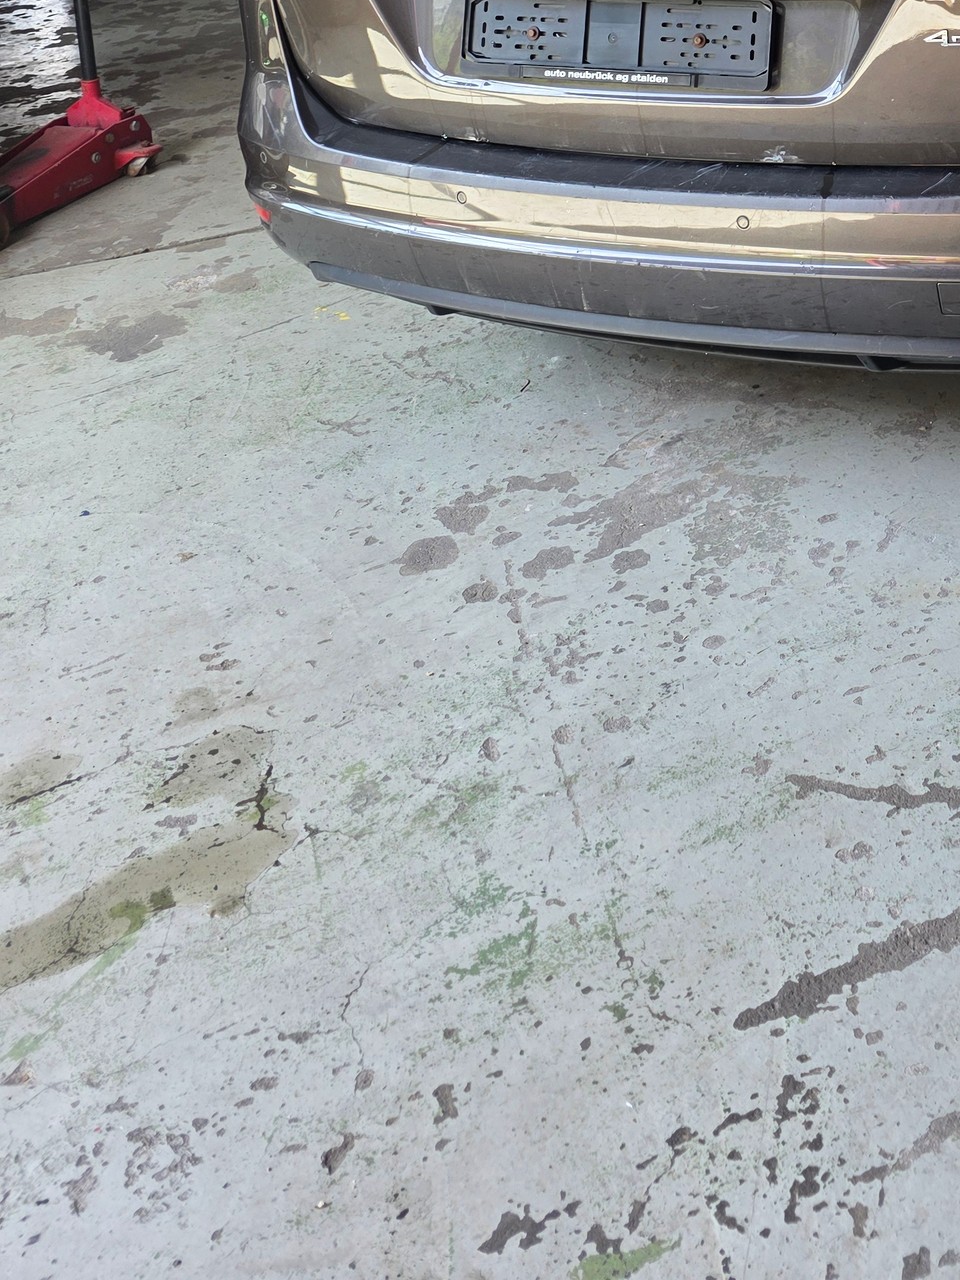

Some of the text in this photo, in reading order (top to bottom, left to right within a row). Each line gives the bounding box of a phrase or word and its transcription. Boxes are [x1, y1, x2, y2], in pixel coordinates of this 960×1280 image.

[544, 69, 669, 84] auto neubrück ag stalden
